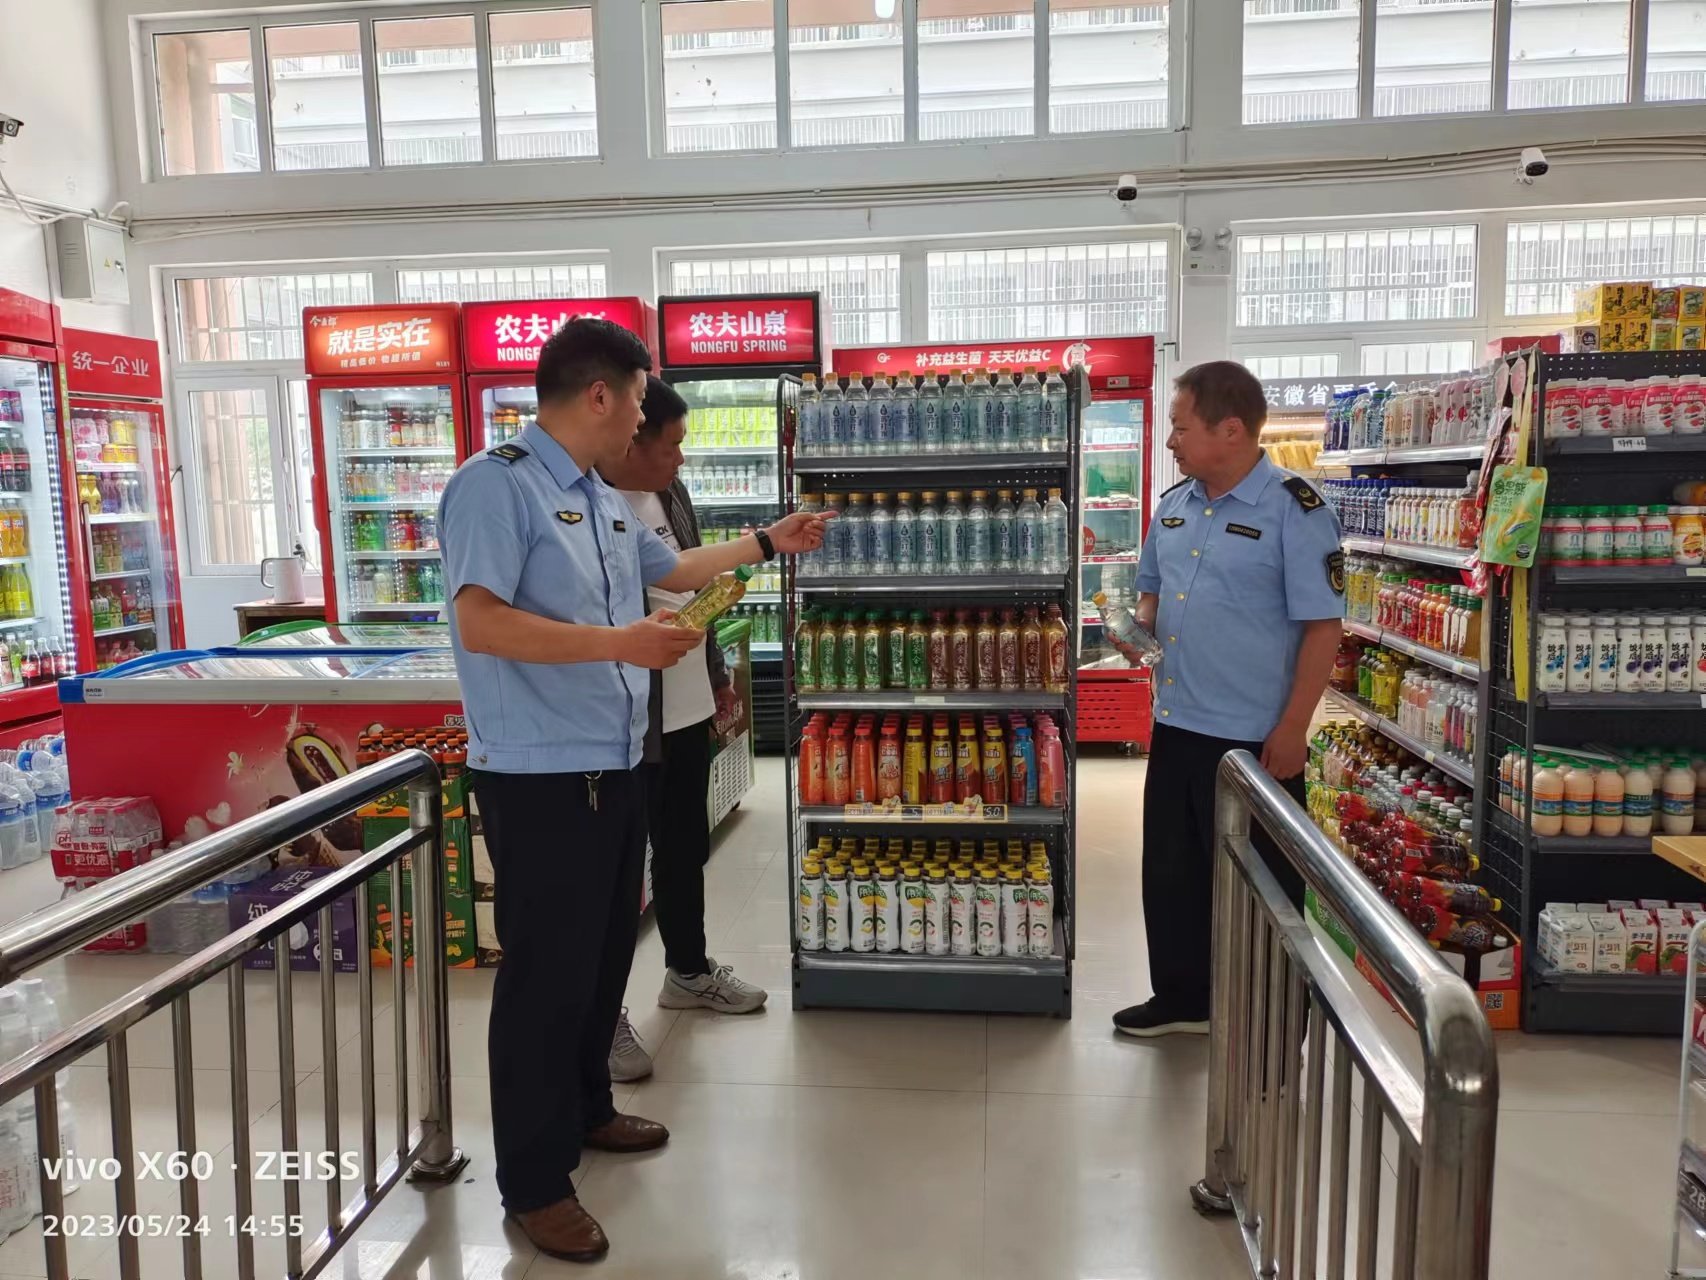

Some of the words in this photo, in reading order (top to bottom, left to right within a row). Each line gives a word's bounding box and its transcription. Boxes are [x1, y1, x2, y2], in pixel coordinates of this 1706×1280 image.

[689, 311, 787, 337] 农夫山泉
[327, 317, 431, 355] 就是实在
[691, 341, 738, 353] NONGFU
[743, 339, 787, 352] SPRING
[72, 350, 149, 377] 统一企业
[497, 347, 540, 361] NONGF
[916, 351, 981, 367] 补充益生菌
[988, 348, 1051, 364] 天天优益C
